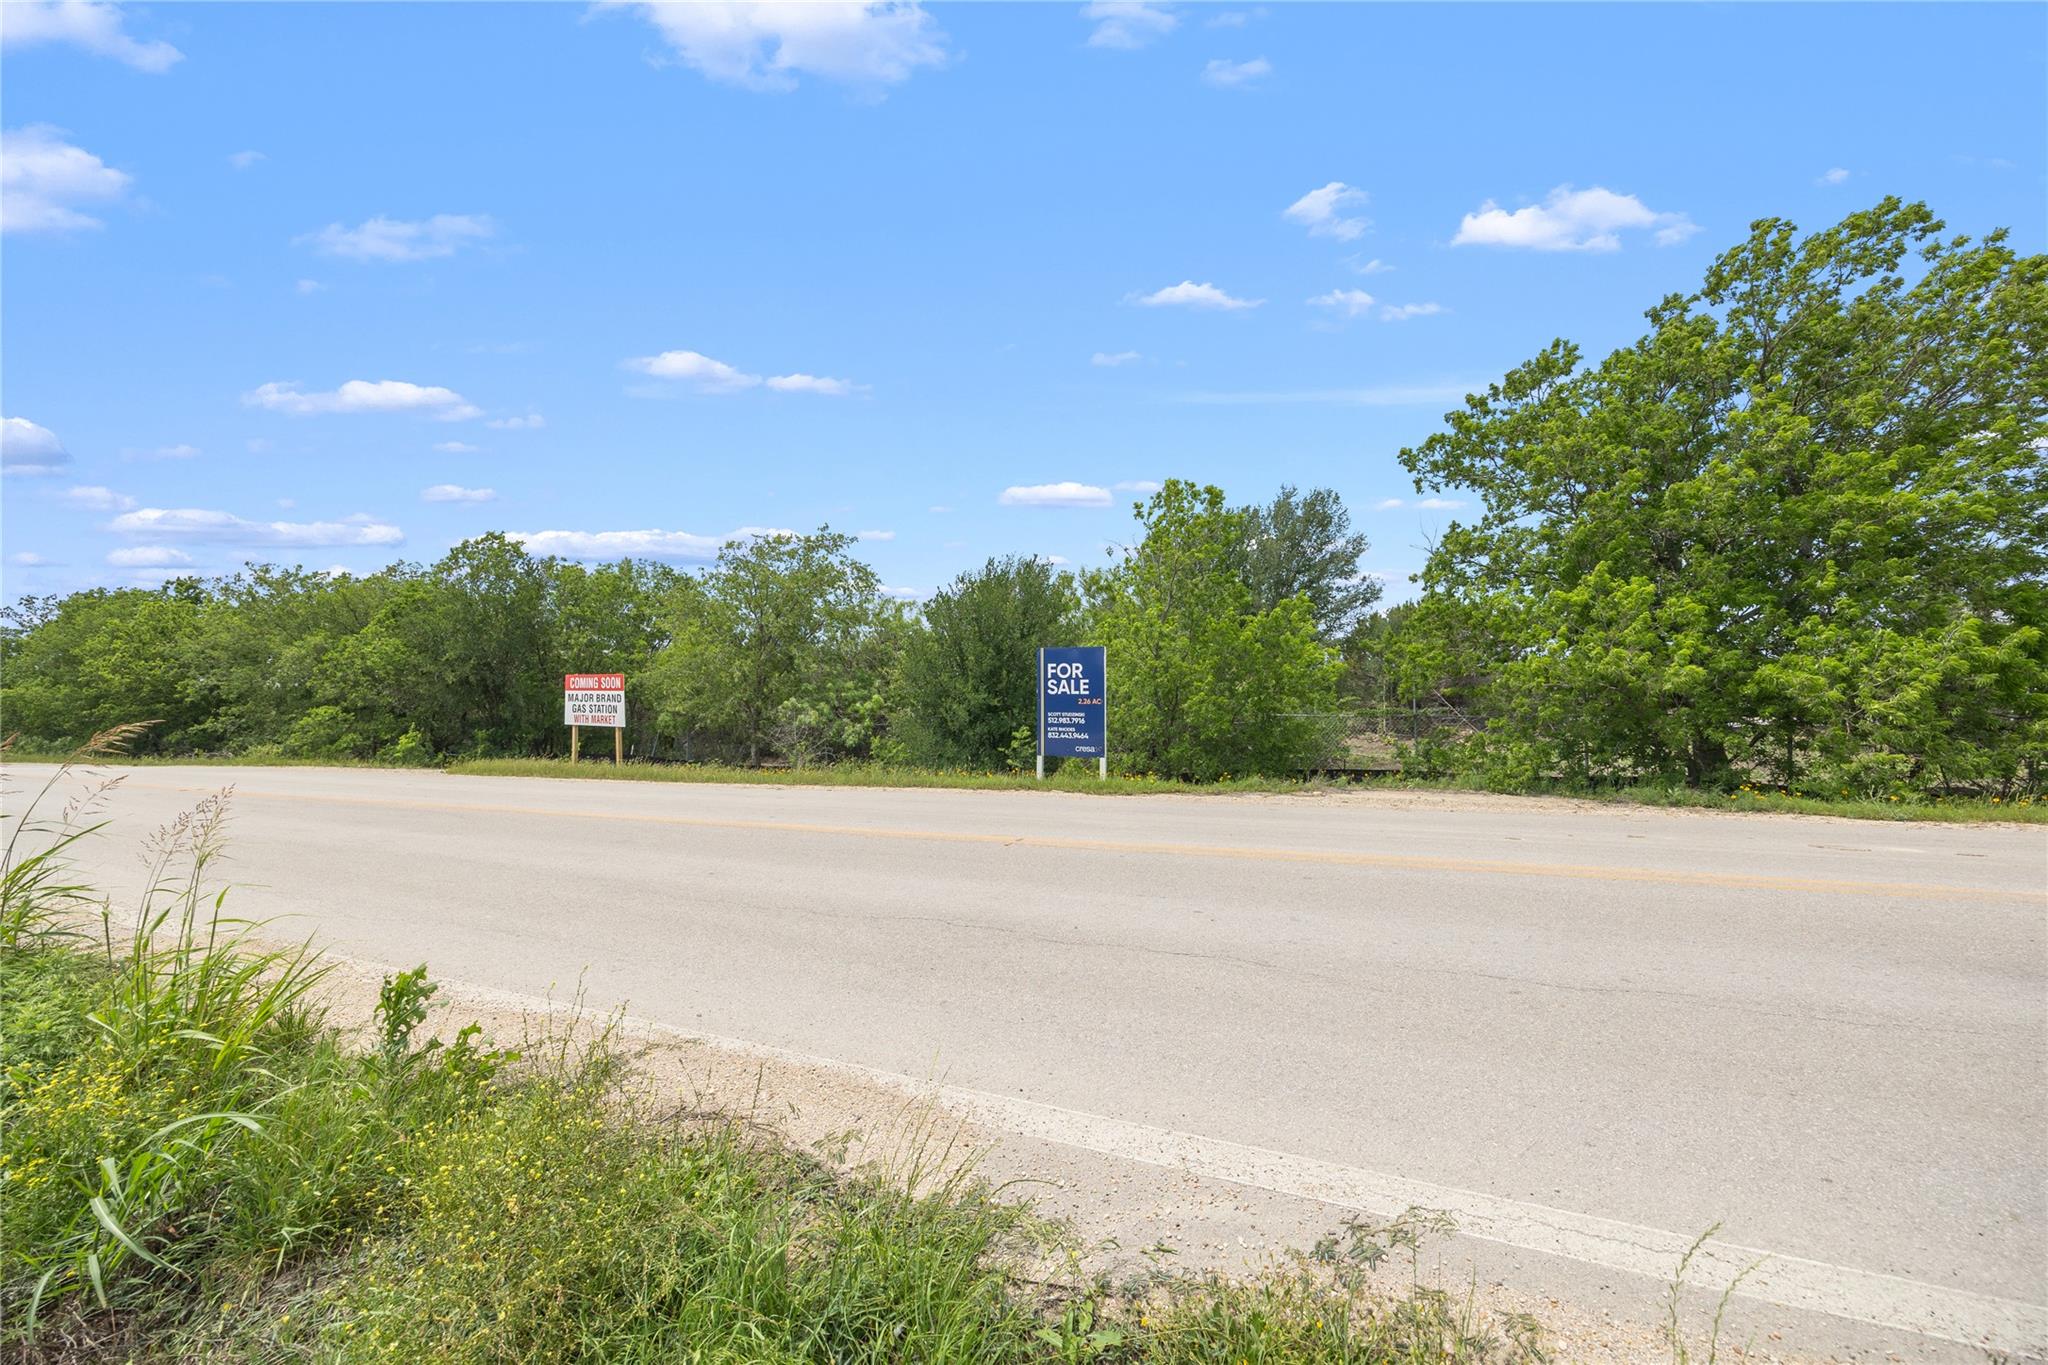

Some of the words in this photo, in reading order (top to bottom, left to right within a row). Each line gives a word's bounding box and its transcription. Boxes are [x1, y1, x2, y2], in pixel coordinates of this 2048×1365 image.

[1048, 662, 1083, 678] FOR
[570, 677, 598, 688] COMING
[600, 677, 621, 688] SOON
[1048, 679, 1090, 695] SALE
[568, 694, 594, 702] MAJOR
[596, 694, 622, 702] BRAND
[572, 704, 586, 713] GAS
[589, 704, 618, 714] STATION
[574, 714, 589, 724] WITH
[591, 714, 616, 724] MARKET
